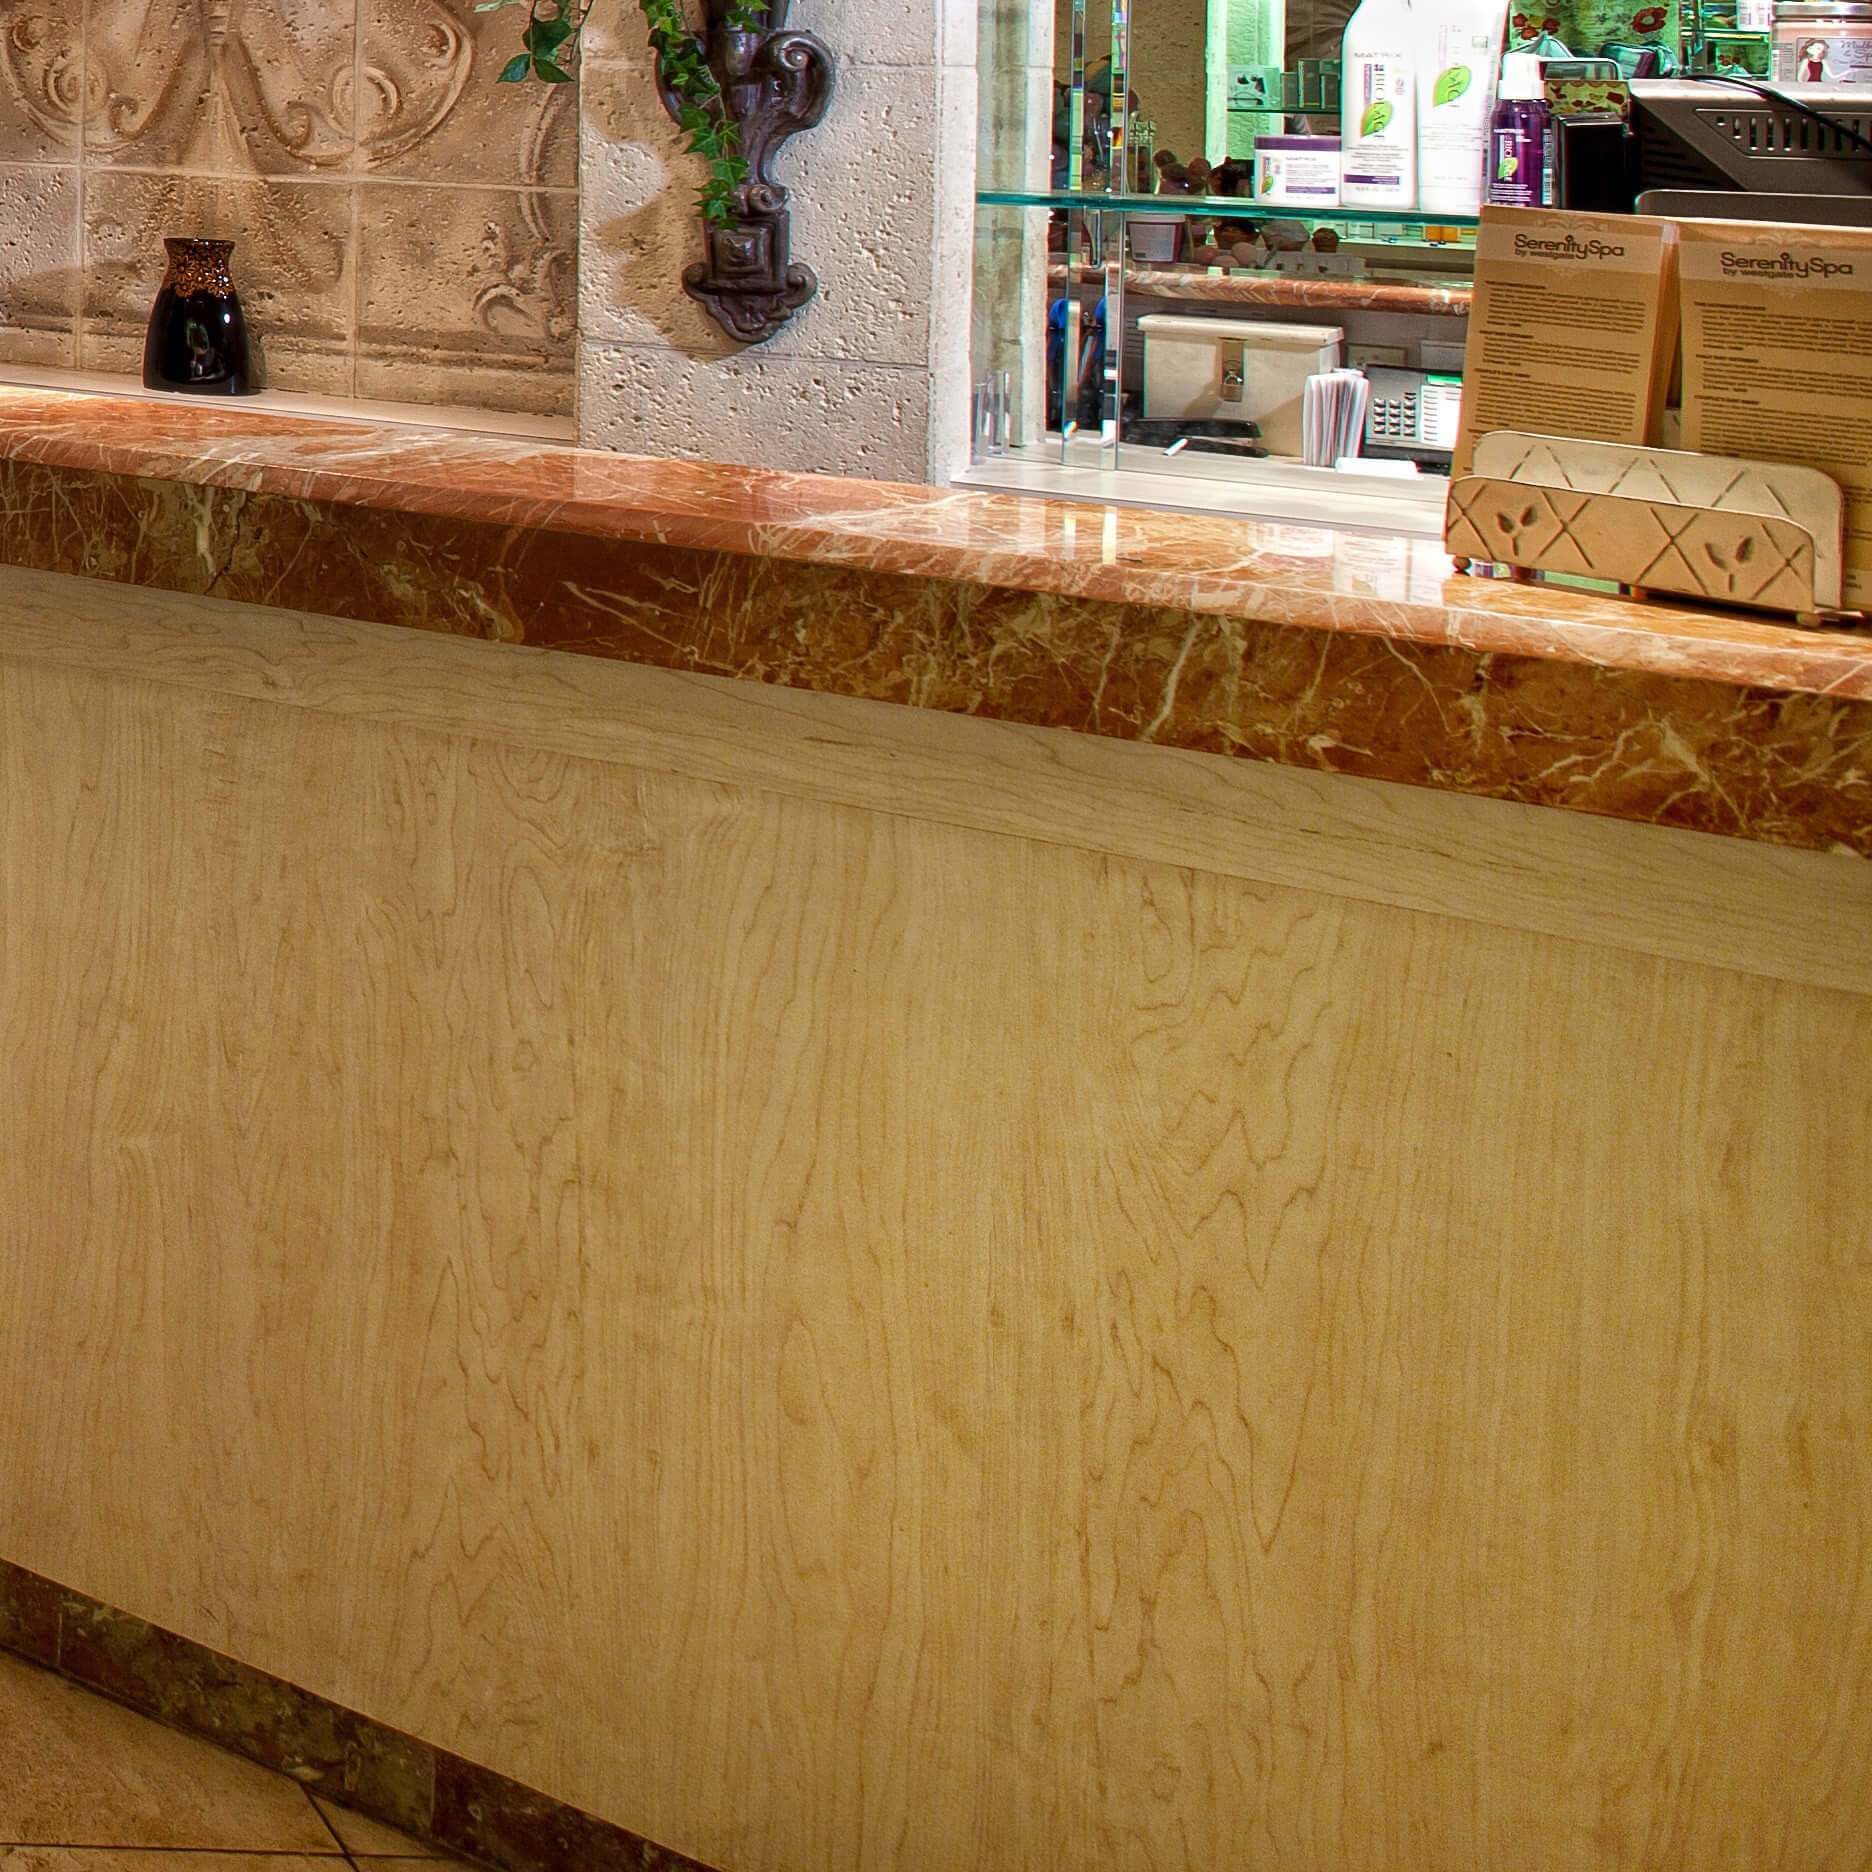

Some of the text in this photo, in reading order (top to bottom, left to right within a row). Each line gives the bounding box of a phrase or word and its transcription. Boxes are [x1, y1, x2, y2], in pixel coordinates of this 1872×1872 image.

[1514, 248, 1575, 261] by westgate
[1722, 267, 1795, 280] by westgate
